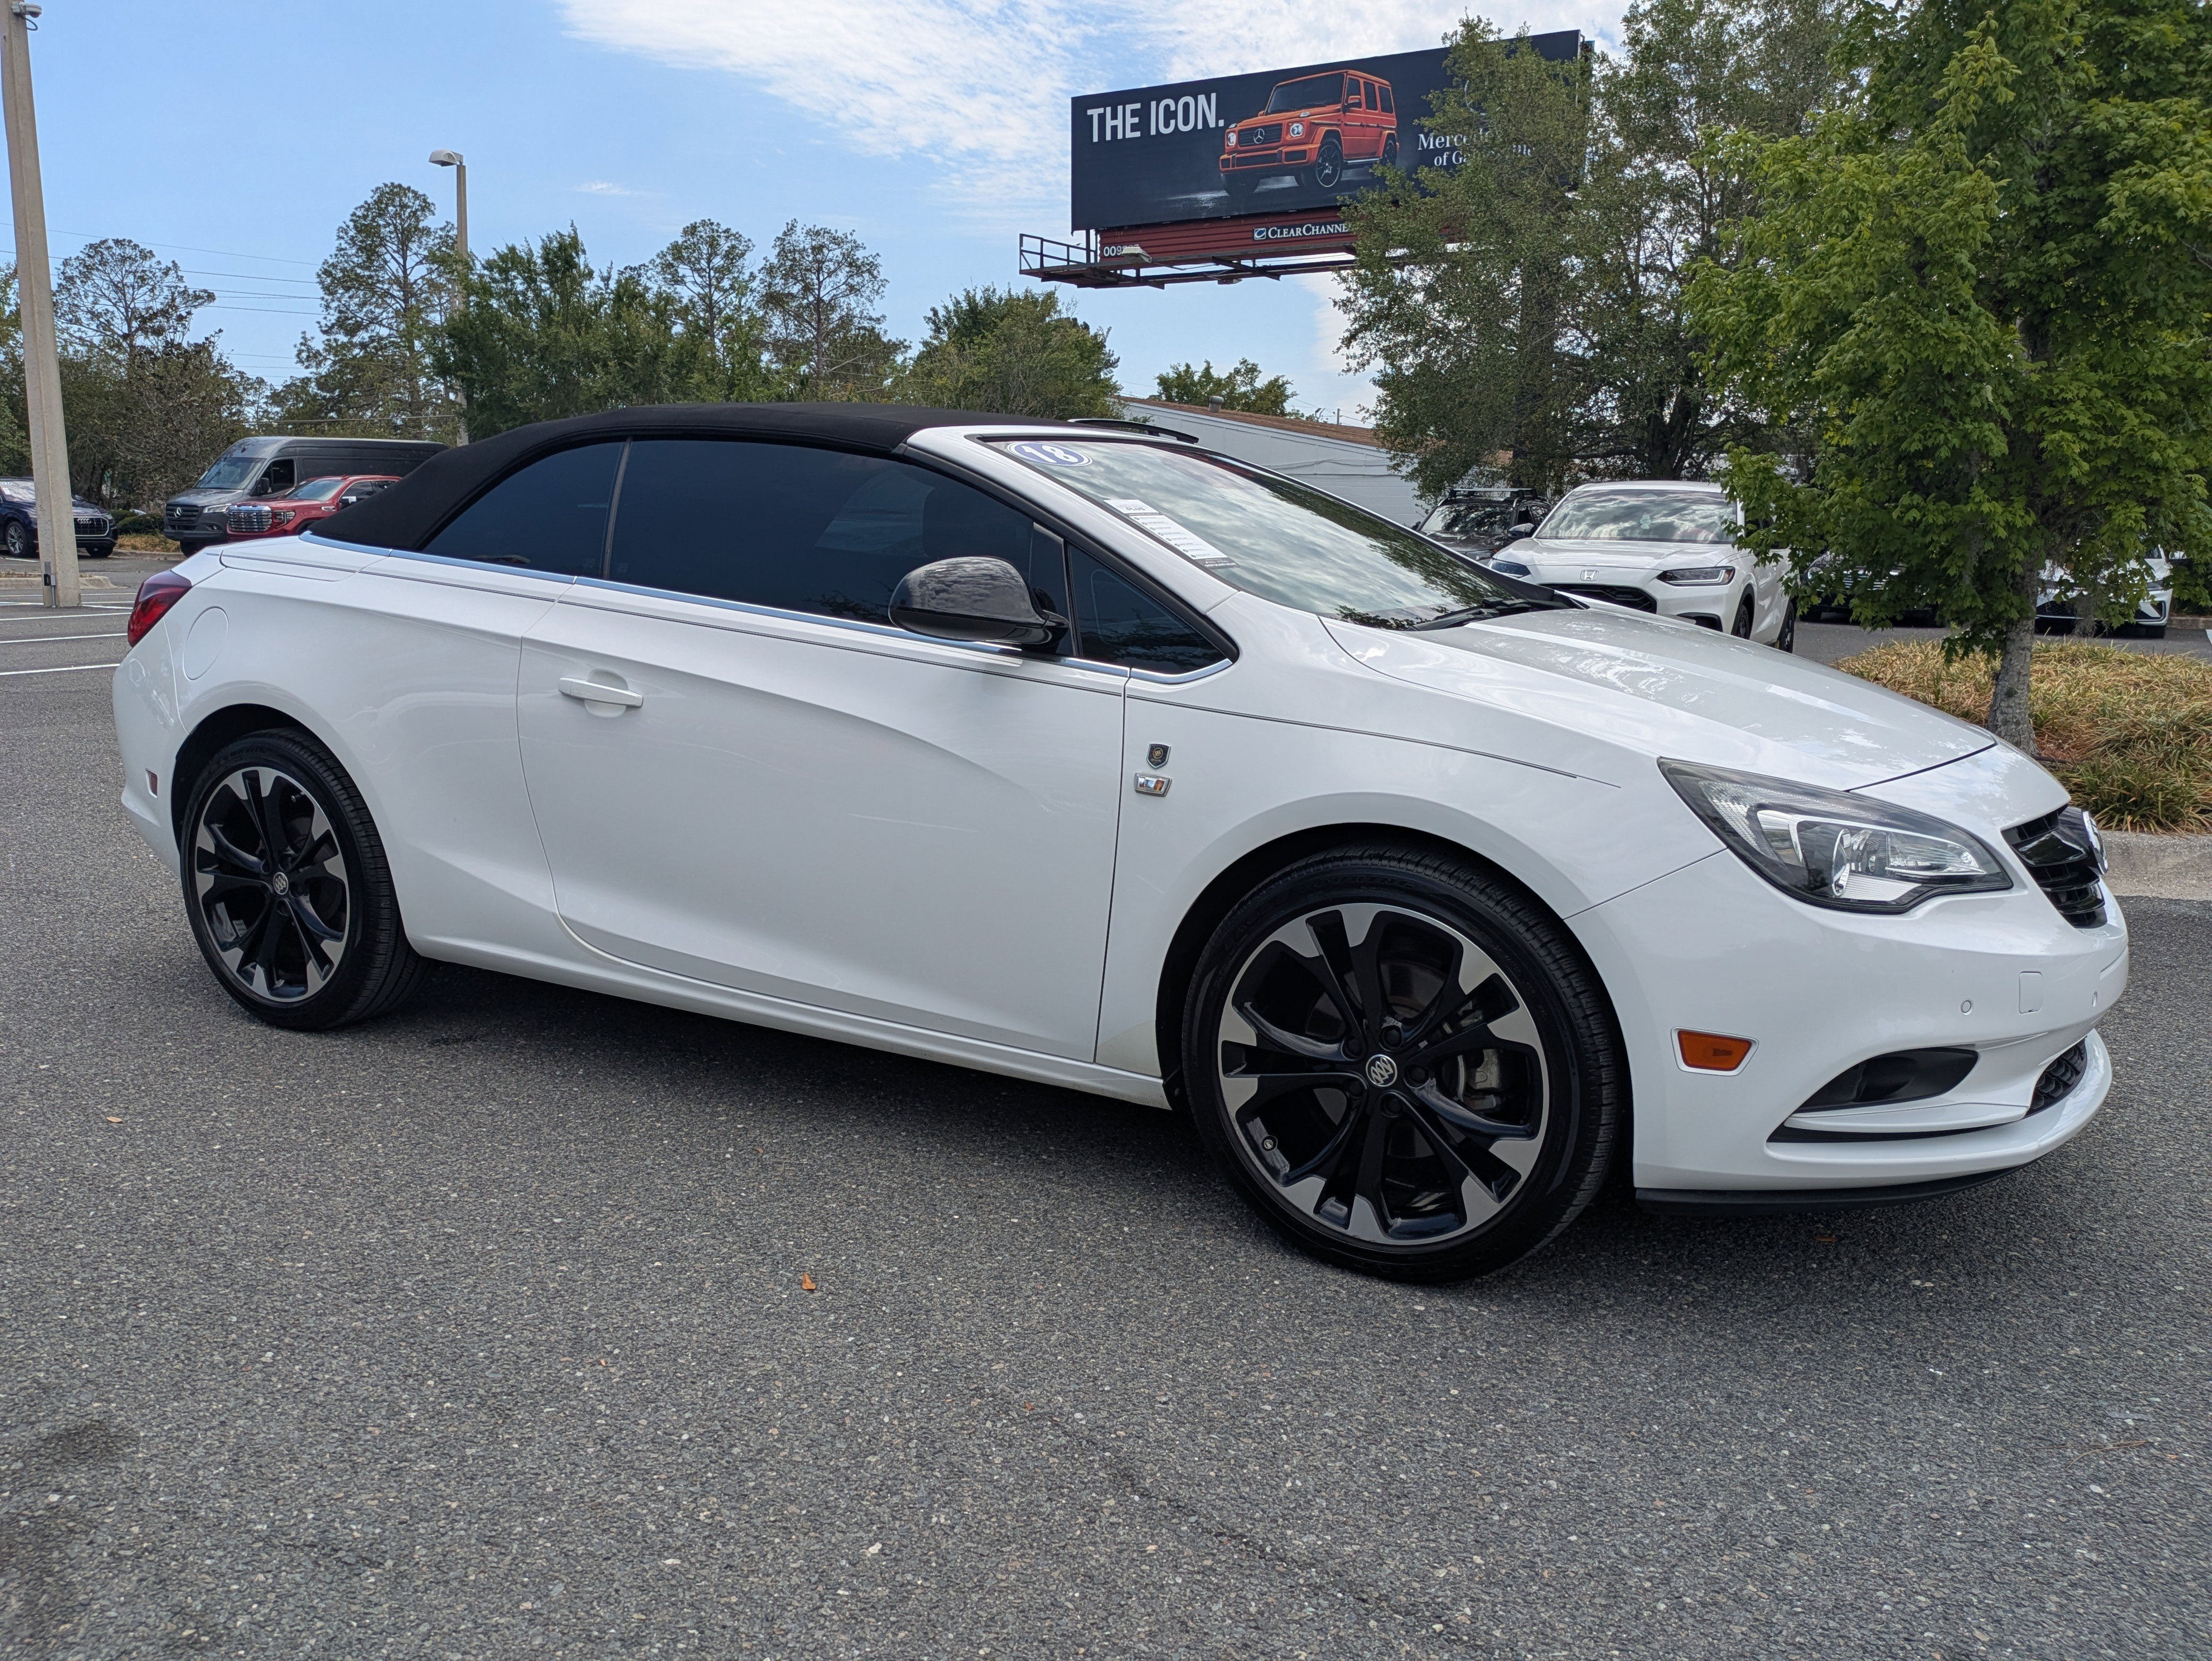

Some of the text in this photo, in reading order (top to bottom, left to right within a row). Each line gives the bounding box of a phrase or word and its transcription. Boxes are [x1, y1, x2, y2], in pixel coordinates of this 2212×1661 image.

[1086, 92, 1225, 143] THE ICON.
[1434, 151, 1449, 166] of
[1268, 223, 1350, 239] CLEARCHANNE
[1021, 445, 1078, 463] 18
